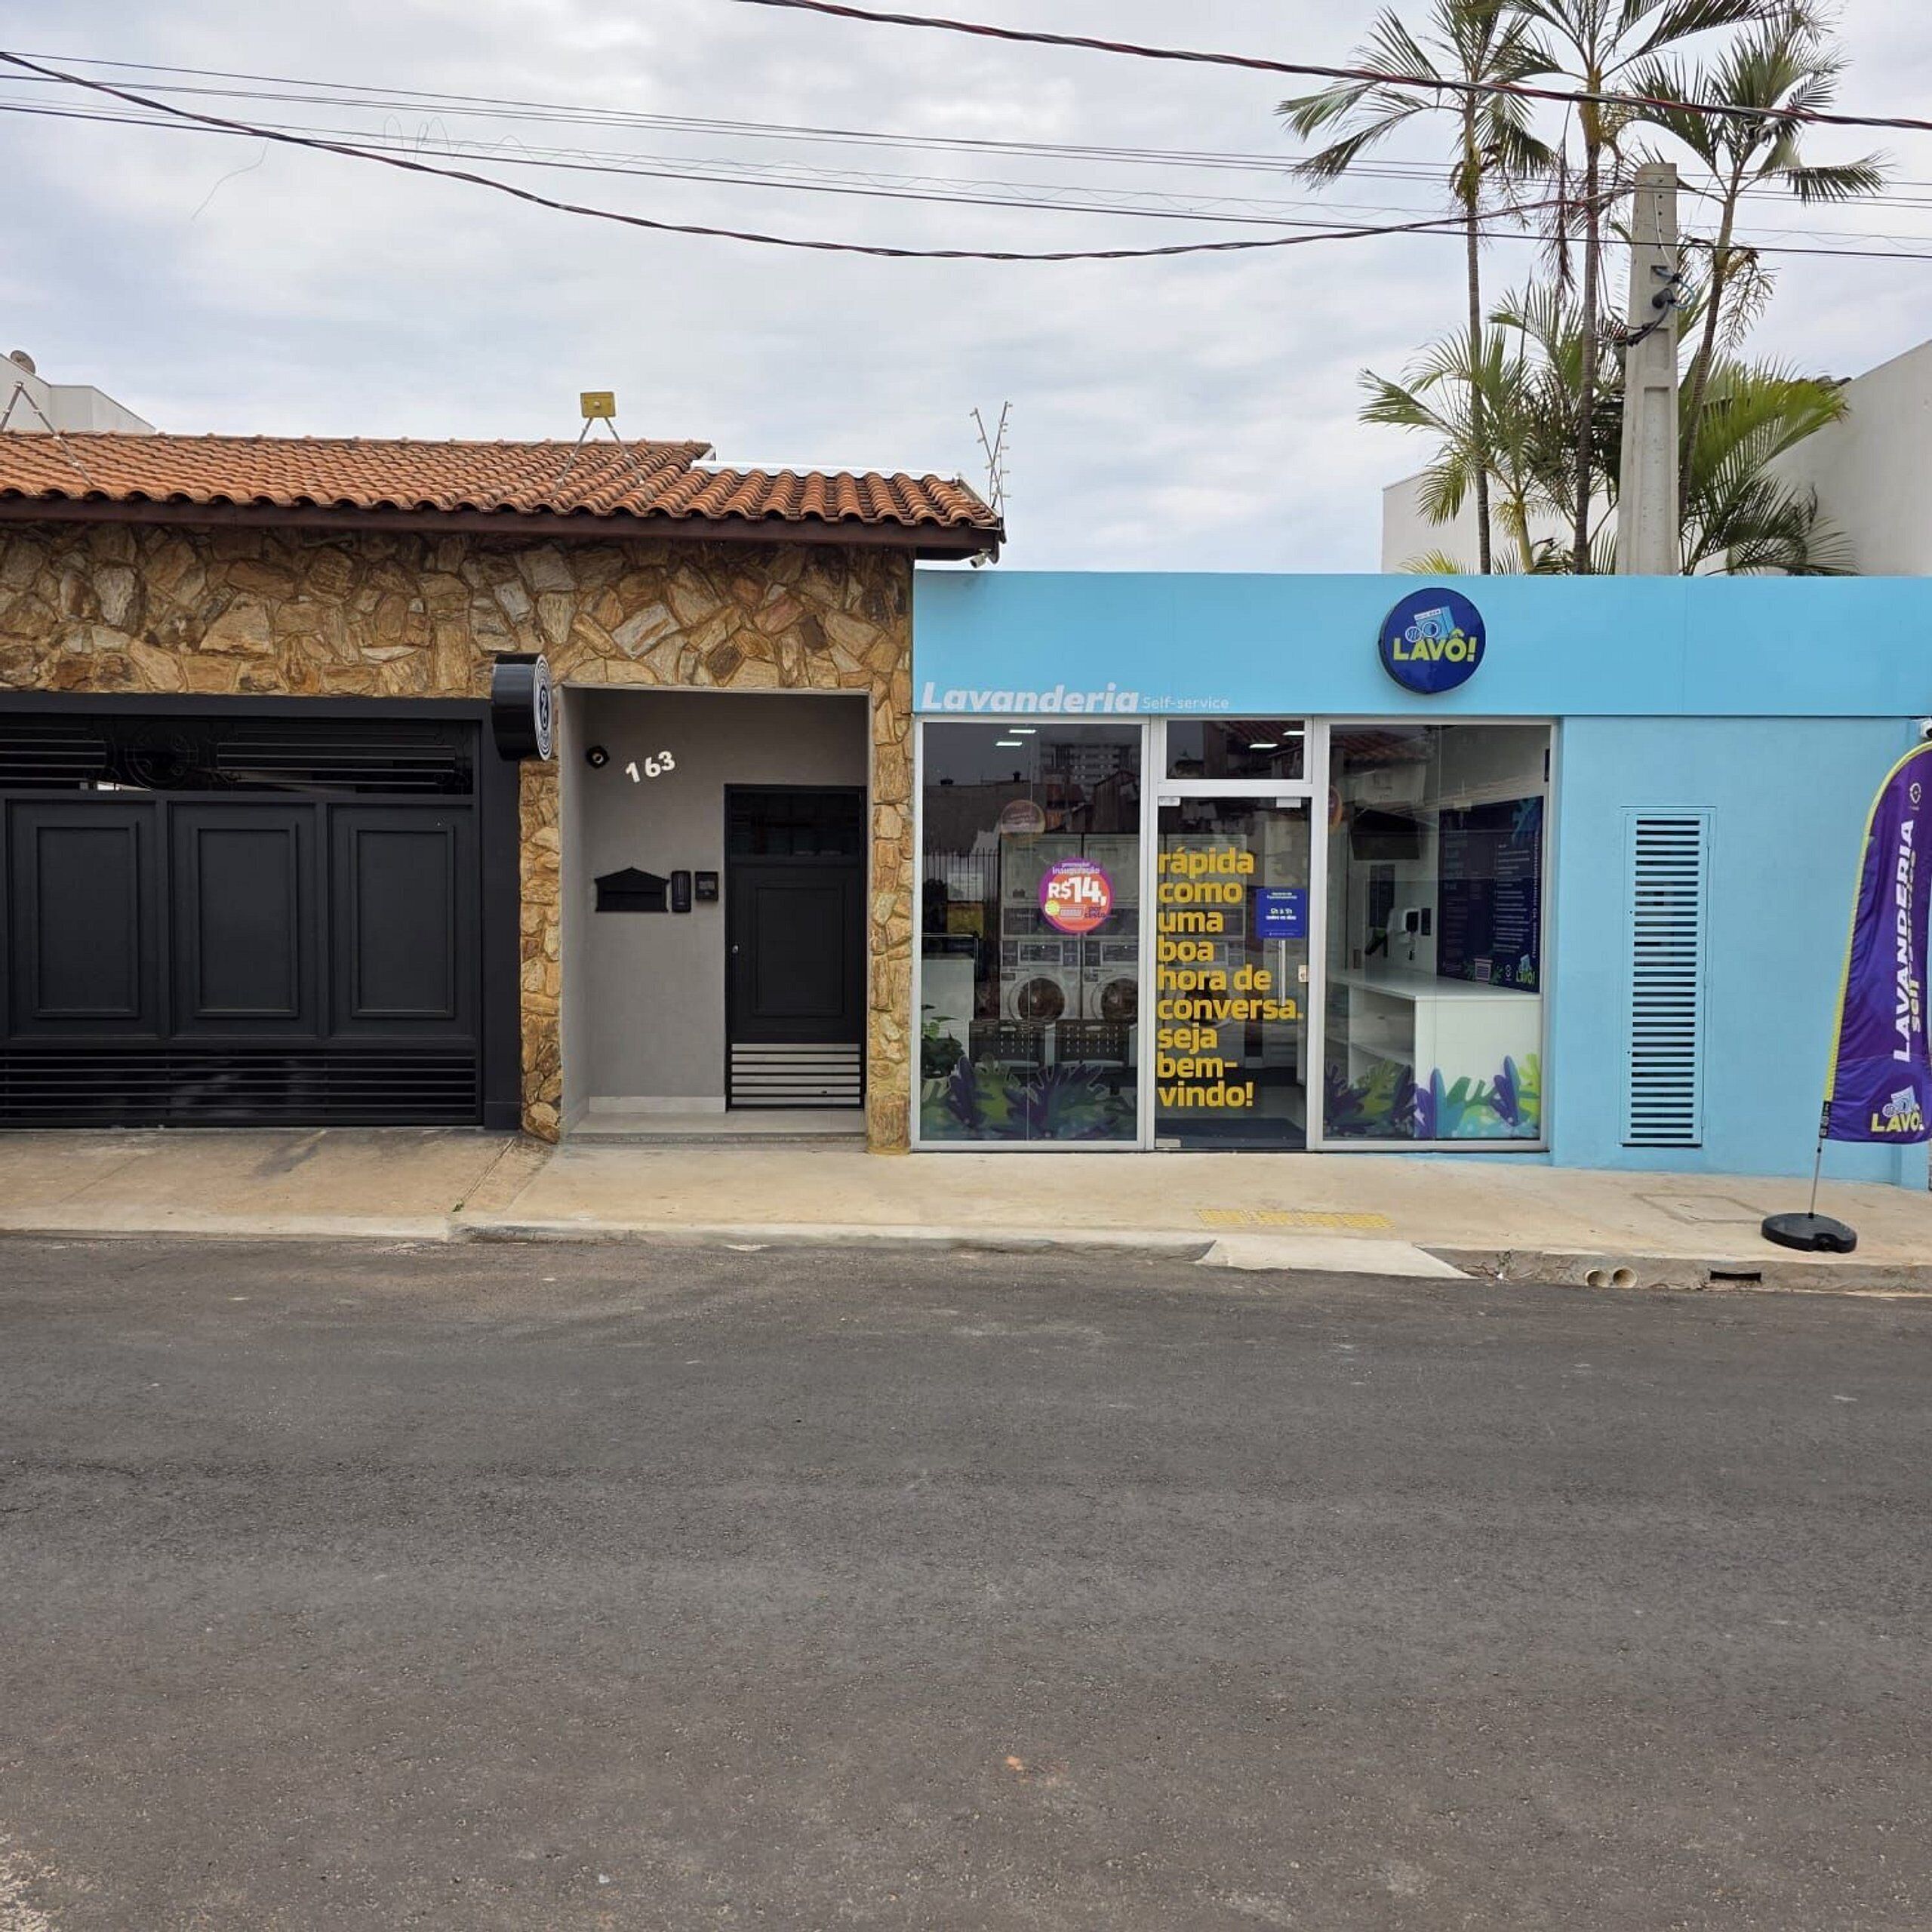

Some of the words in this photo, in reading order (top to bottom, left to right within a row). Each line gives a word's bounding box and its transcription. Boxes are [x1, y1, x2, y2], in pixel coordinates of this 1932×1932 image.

[1393, 628, 1478, 663] LAVÔ!
[921, 682, 1140, 713] Lavanderia
[1143, 695, 1230, 710] Self-service
[625, 750, 675, 783] 163
[1158, 847, 1254, 879] rápida
[1158, 881, 1242, 903] como
[1158, 911, 1224, 932] uma
[1158, 936, 1214, 961] boa
[1893, 820, 1915, 1063] LAVANDERIA
[1158, 964, 1227, 991] hora
[1233, 964, 1272, 991] de
[1158, 1023, 1218, 1054] seja
[1158, 1051, 1238, 1078] bem-
[1158, 1081, 1254, 1106] vindo!
